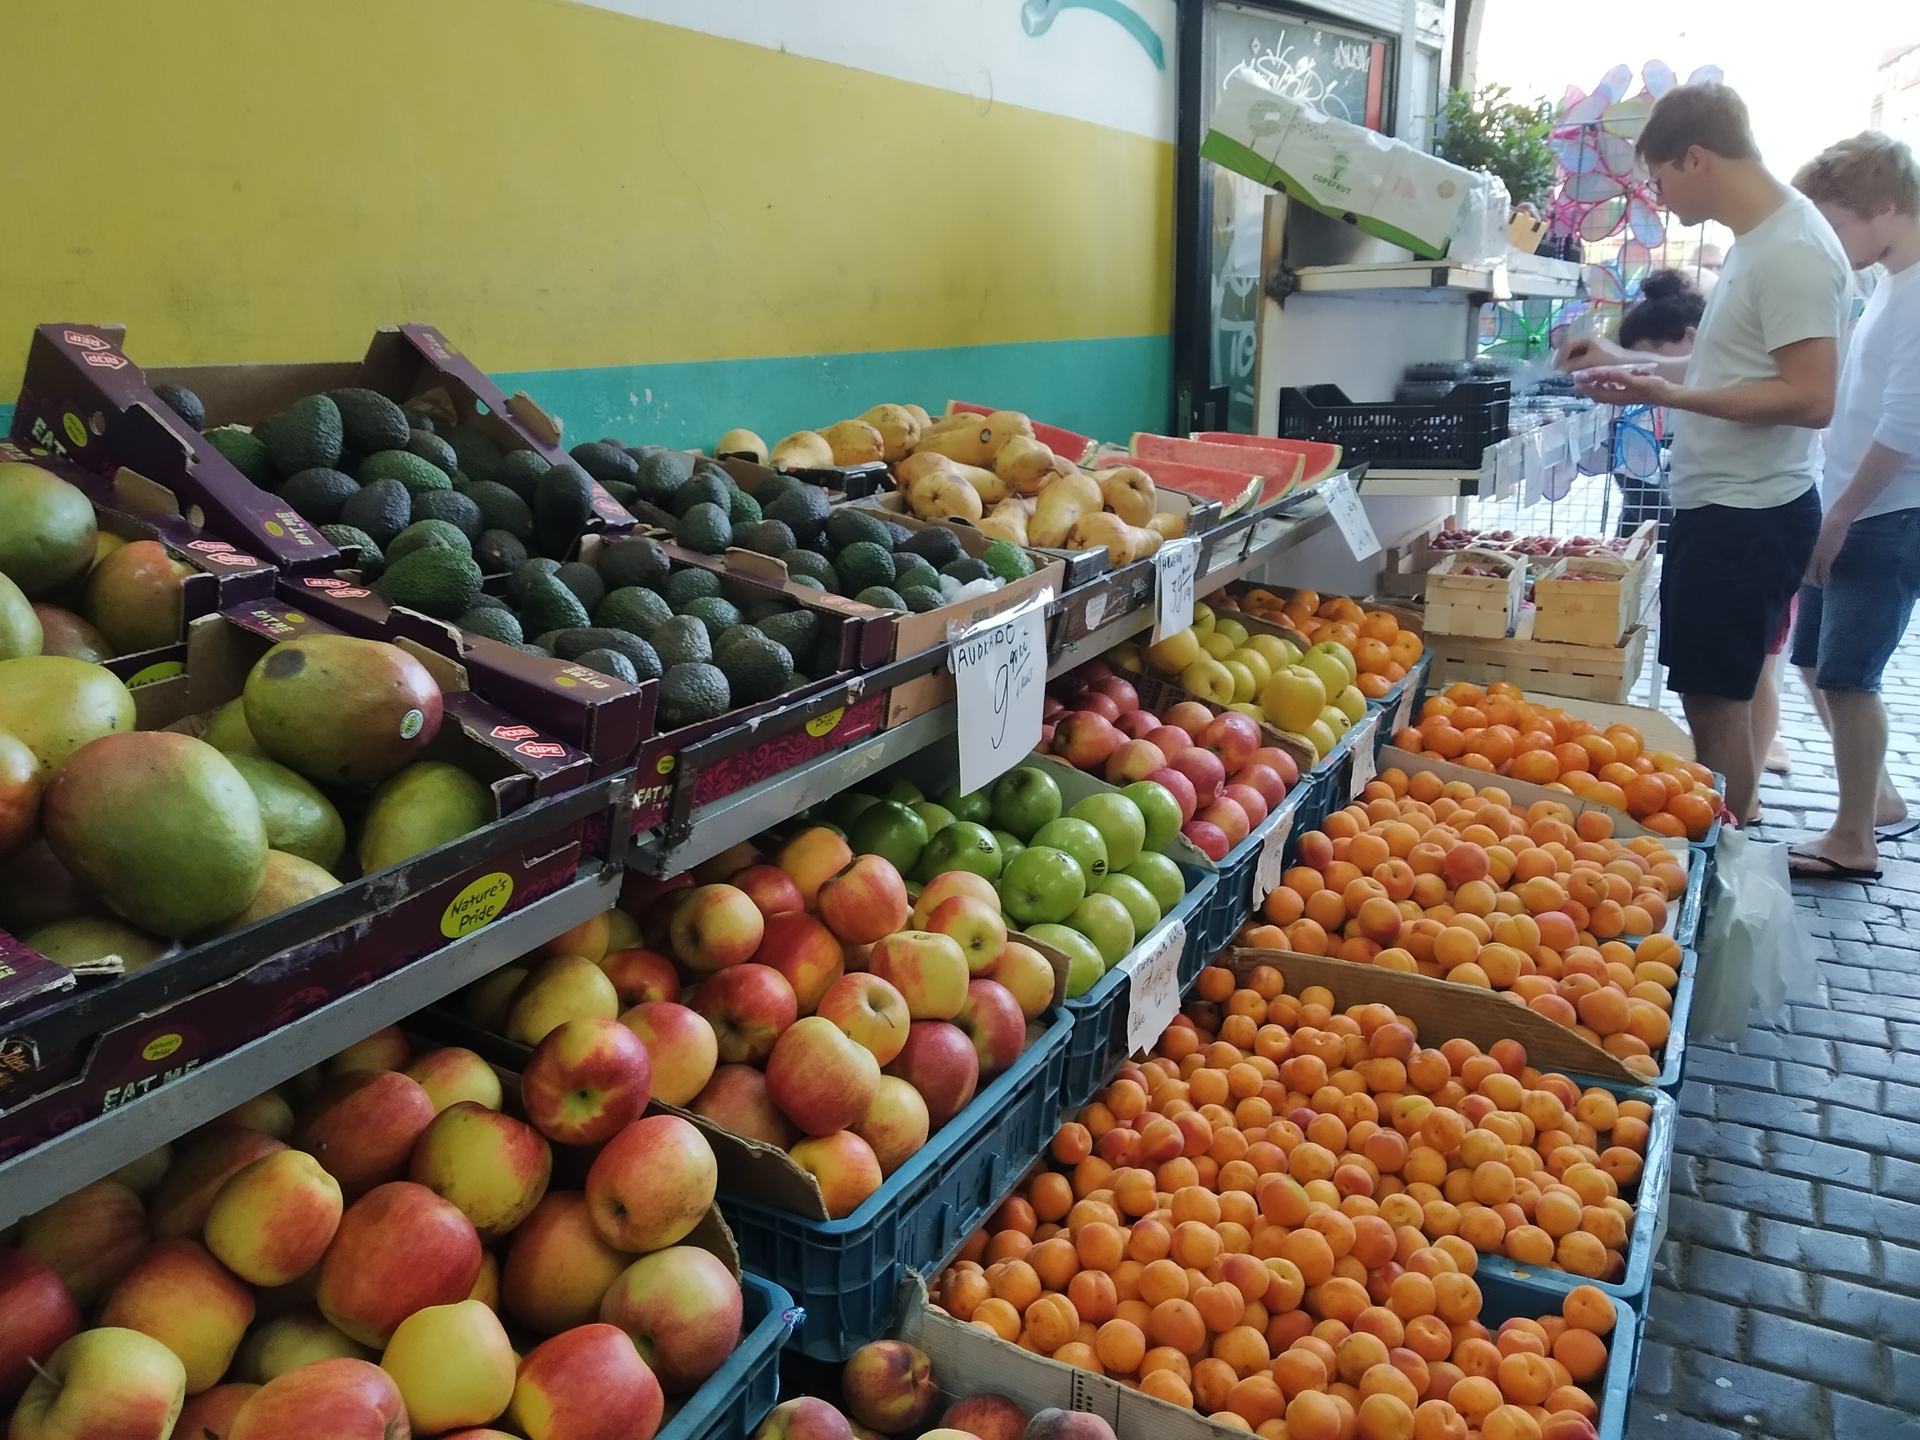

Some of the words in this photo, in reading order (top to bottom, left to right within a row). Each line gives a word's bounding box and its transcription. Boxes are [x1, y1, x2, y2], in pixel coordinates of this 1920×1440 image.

[1312, 173, 1352, 195] COPEFRUT
[815, 714, 835, 731] Pride
[524, 744, 562, 754] RIPE
[637, 785, 662, 804] EAT
[450, 878, 508, 919] Nature's
[458, 905, 496, 932] Pride
[102, 1074, 158, 1113] EAT
